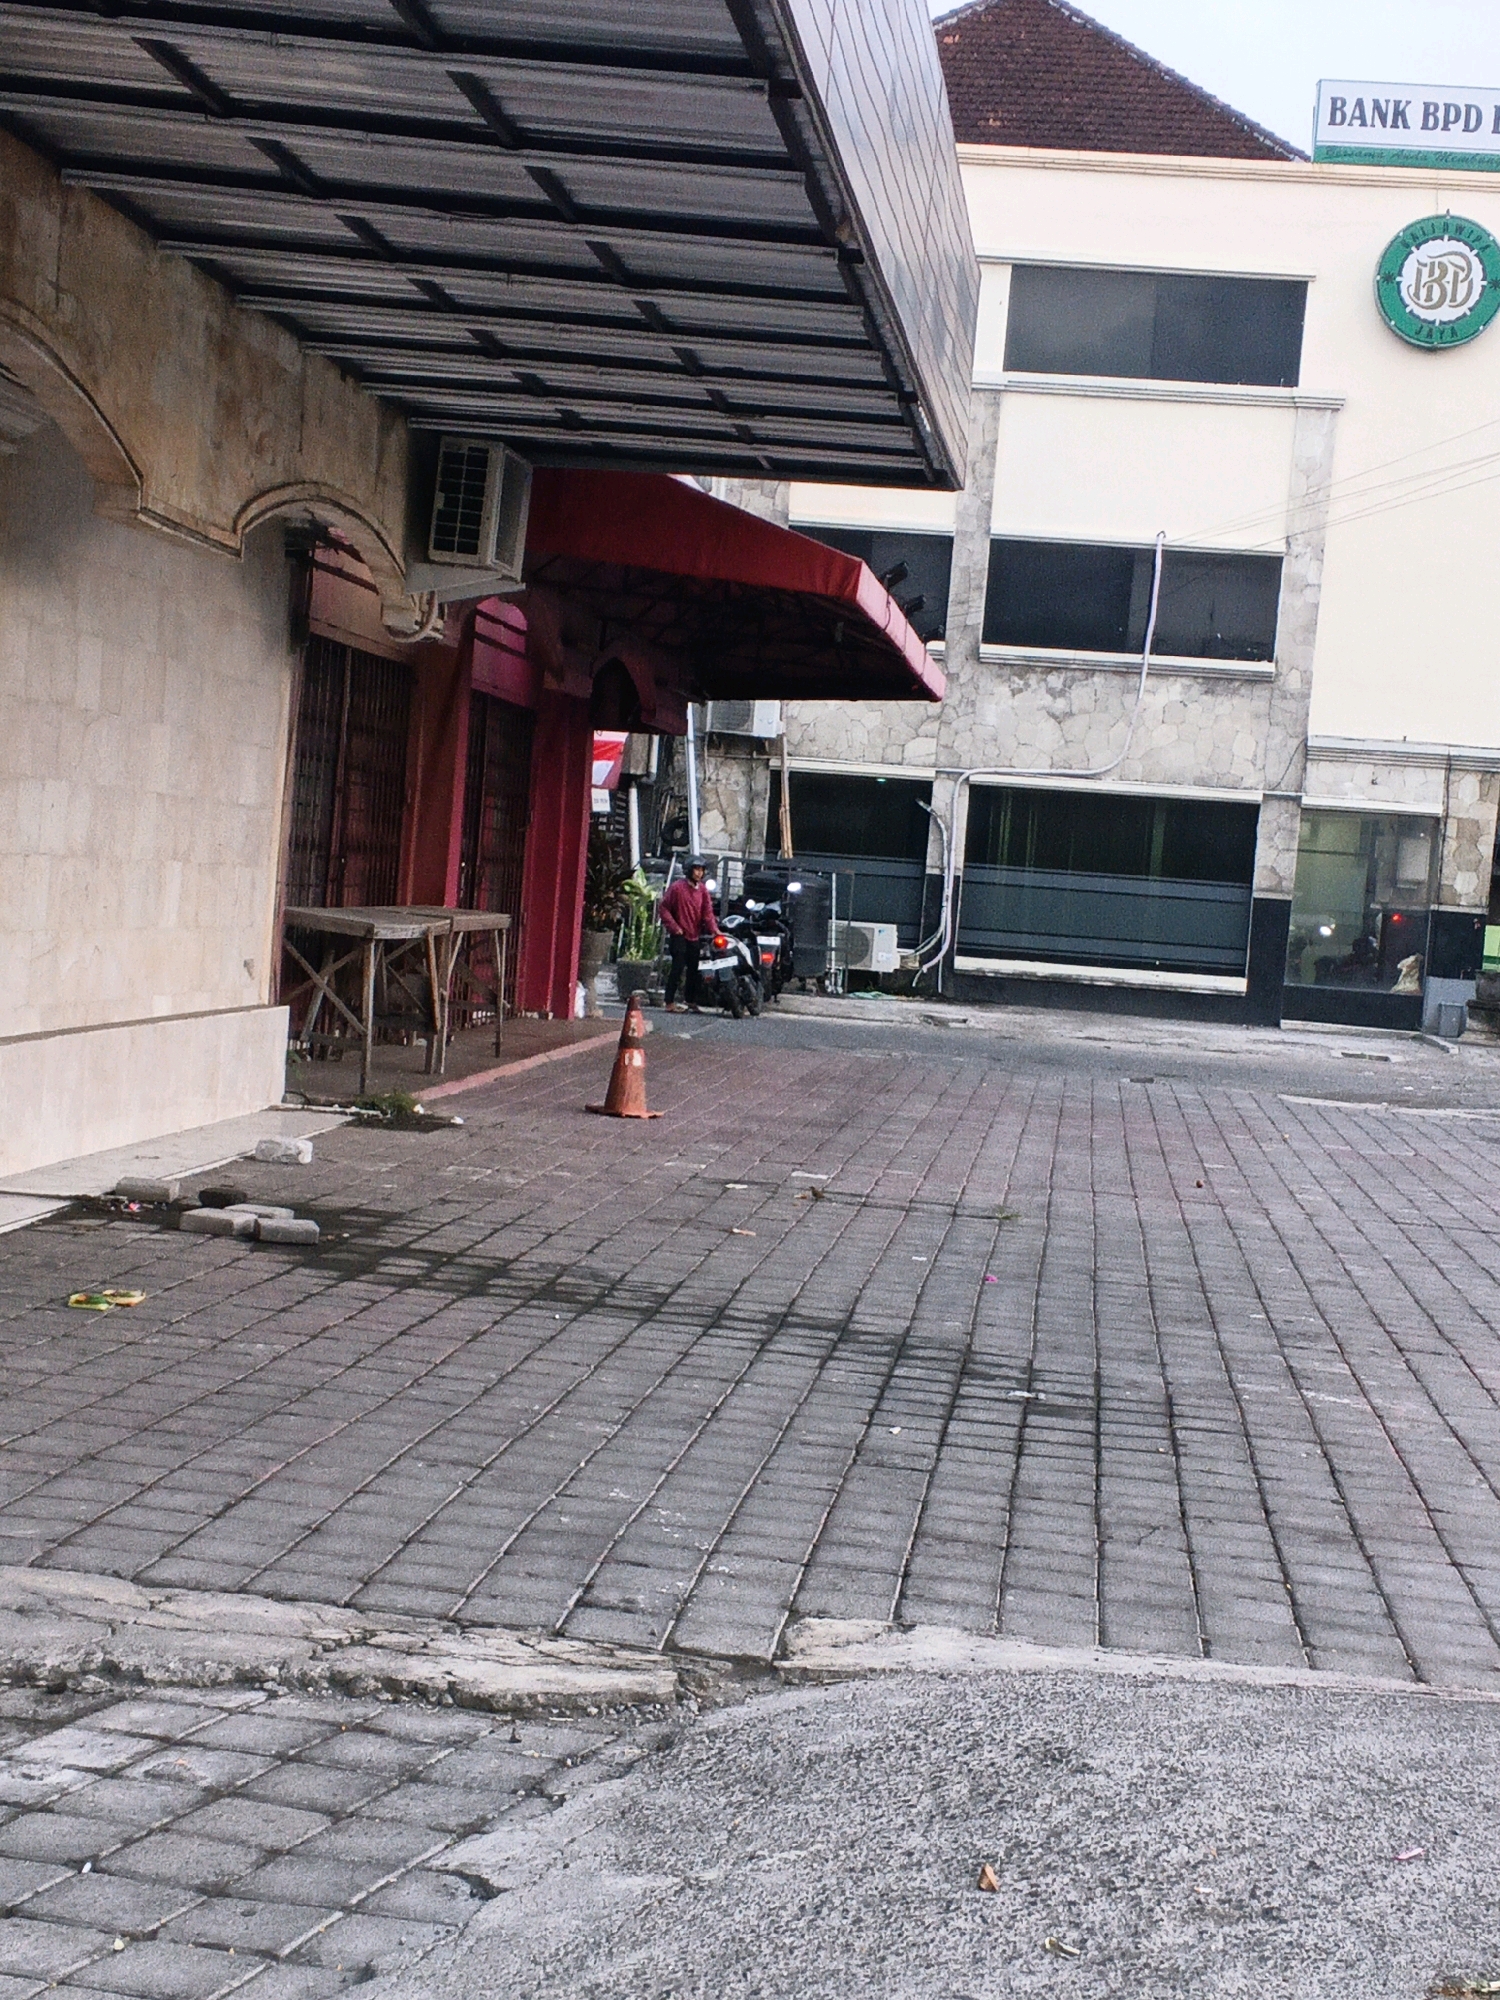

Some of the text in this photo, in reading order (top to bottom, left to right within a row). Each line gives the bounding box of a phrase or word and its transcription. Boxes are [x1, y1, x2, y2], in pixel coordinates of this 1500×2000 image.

[1328, 96, 1412, 130] BANK
[1420, 101, 1483, 133] BPD
[1415, 324, 1459, 340] JAYA
